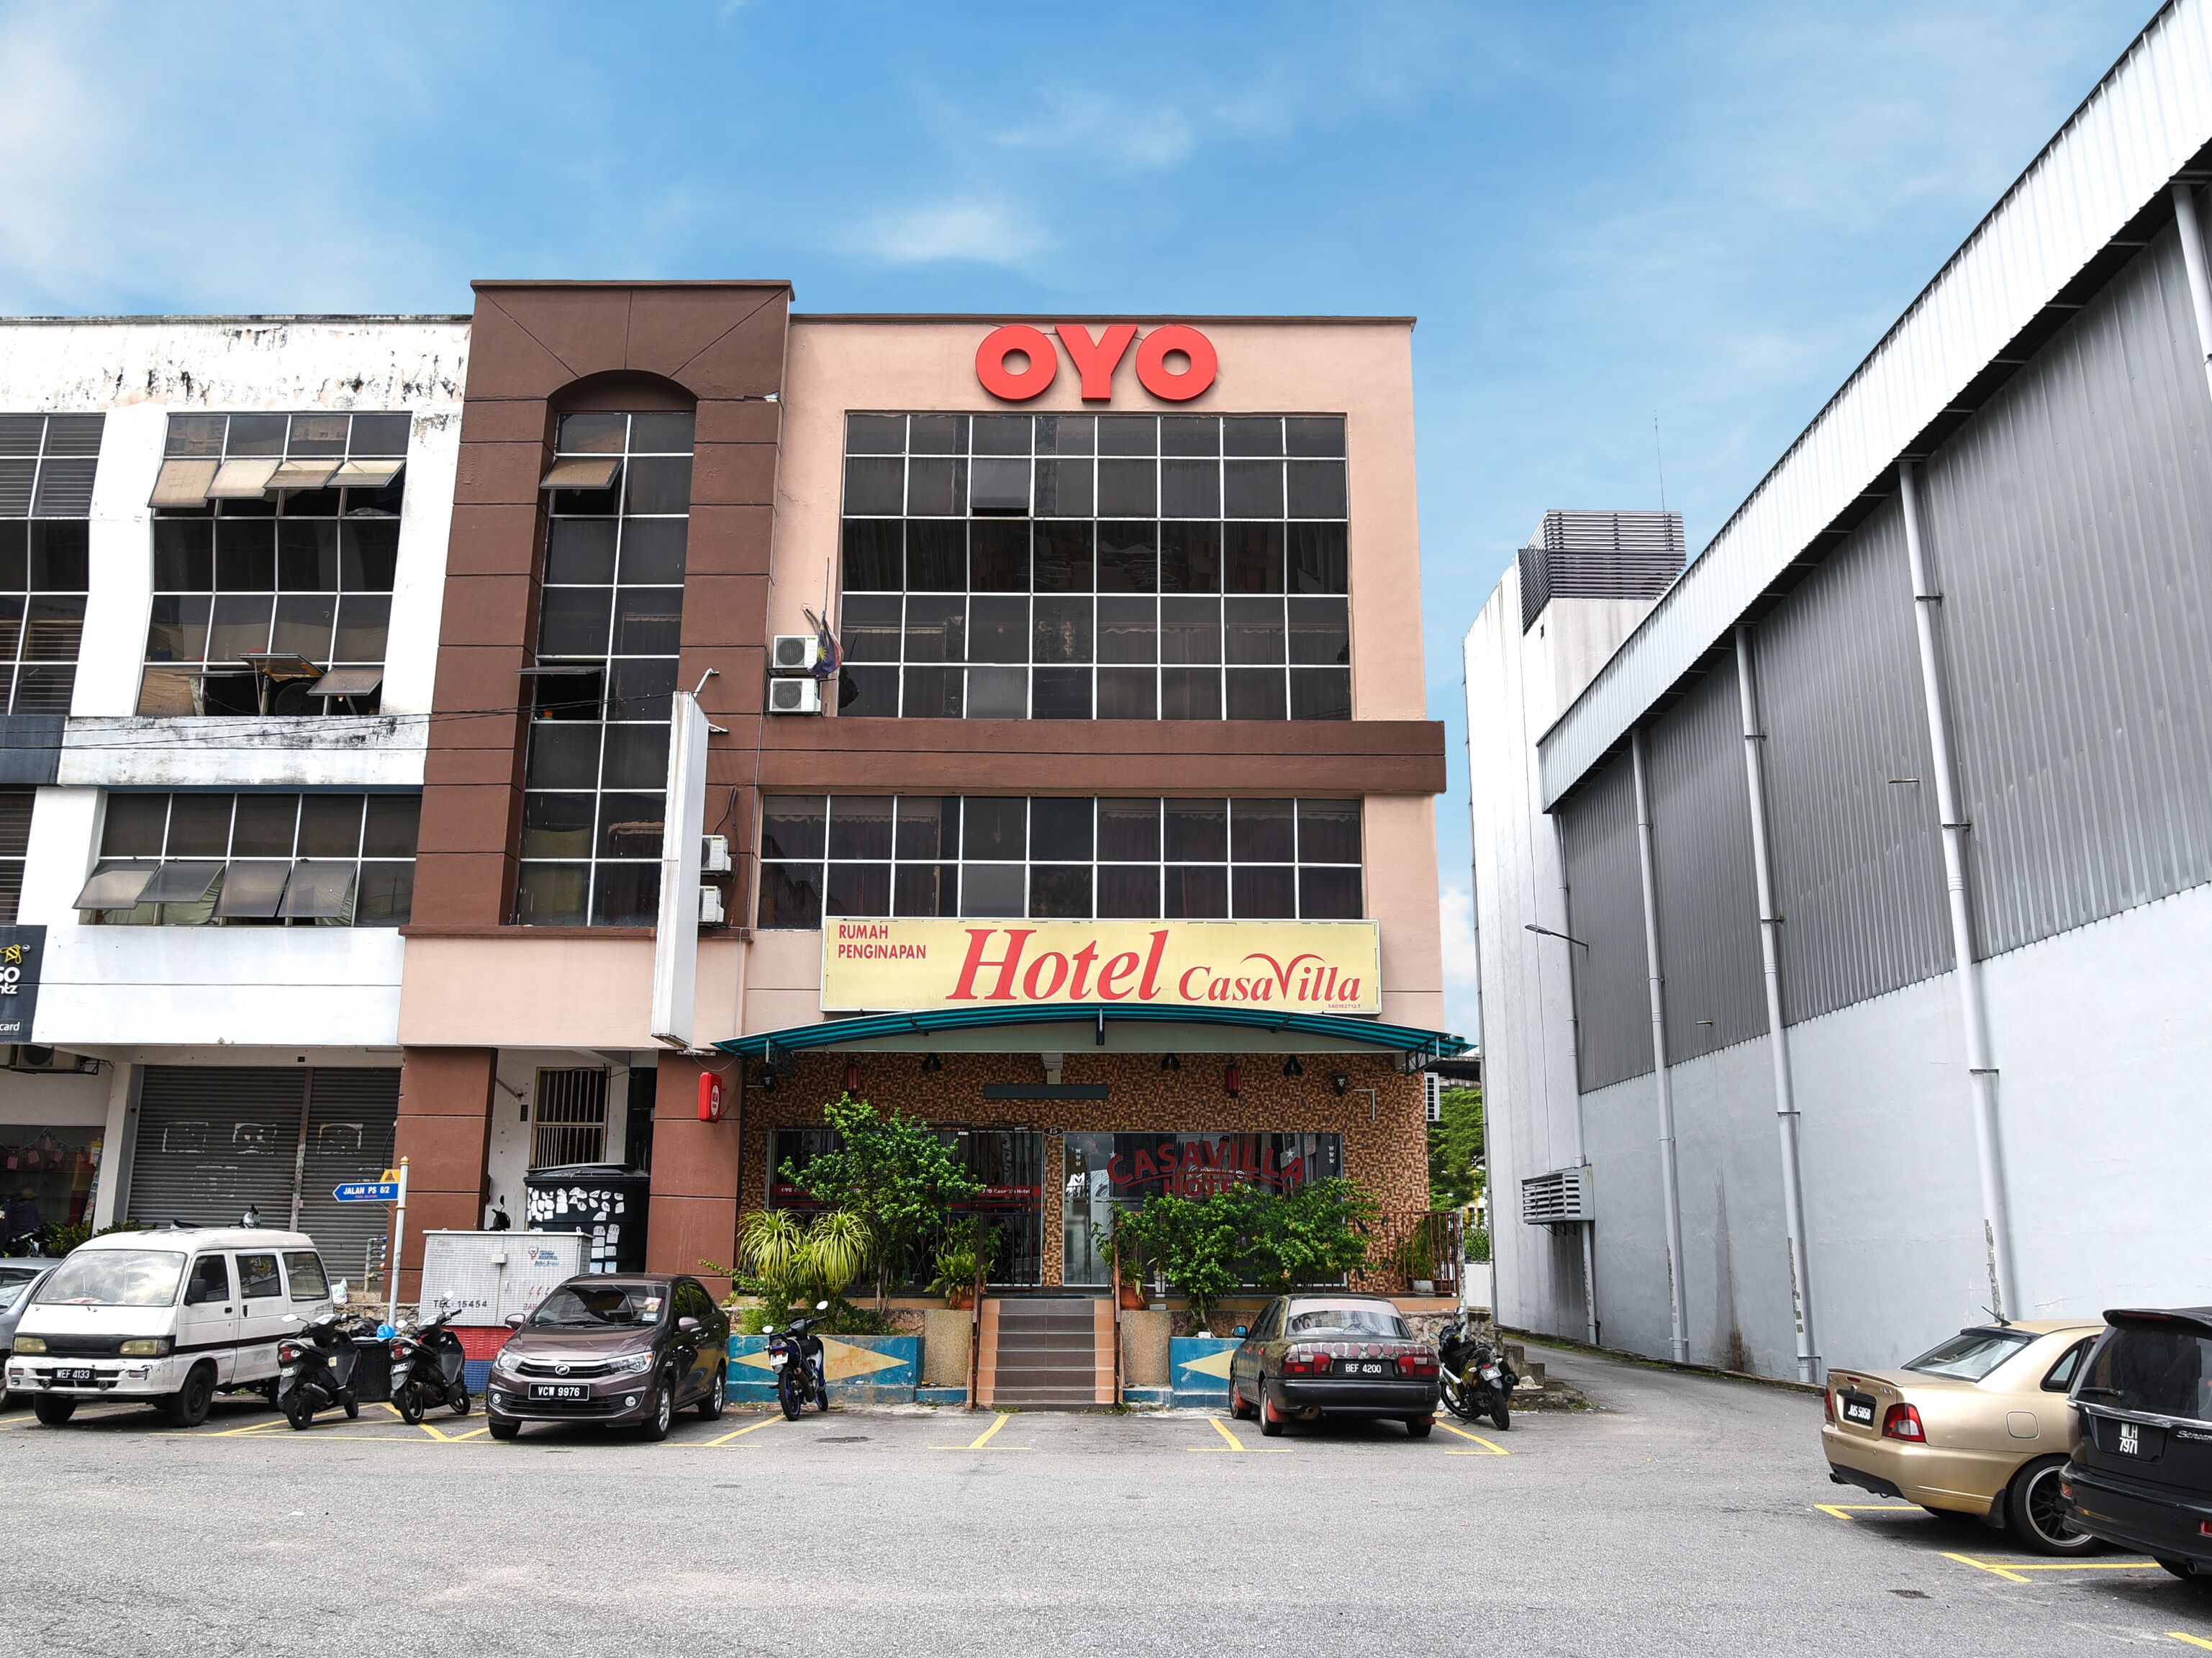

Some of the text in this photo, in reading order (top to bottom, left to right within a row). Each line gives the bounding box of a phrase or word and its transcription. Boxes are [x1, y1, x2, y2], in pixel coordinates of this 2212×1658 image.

[975, 324, 1218, 403] OYO
[838, 925, 888, 939] RUMAH
[838, 944, 926, 959] PENGINAPAN
[945, 928, 1361, 1002] Hotel CasaVilla
[1106, 1141, 1305, 1186] CASAVILLA
[343, 1187, 365, 1195] JALAN
[368, 1186, 377, 1195] PS
[1164, 1179, 1244, 1197] HOTE
[57, 1369, 90, 1379] WEF 4133
[1345, 1363, 1382, 1374] BEF 4200
[538, 1386, 580, 1397] VCW 9976
[2121, 1423, 2138, 1440] WLH
[2119, 1437, 2138, 1454] 7971
